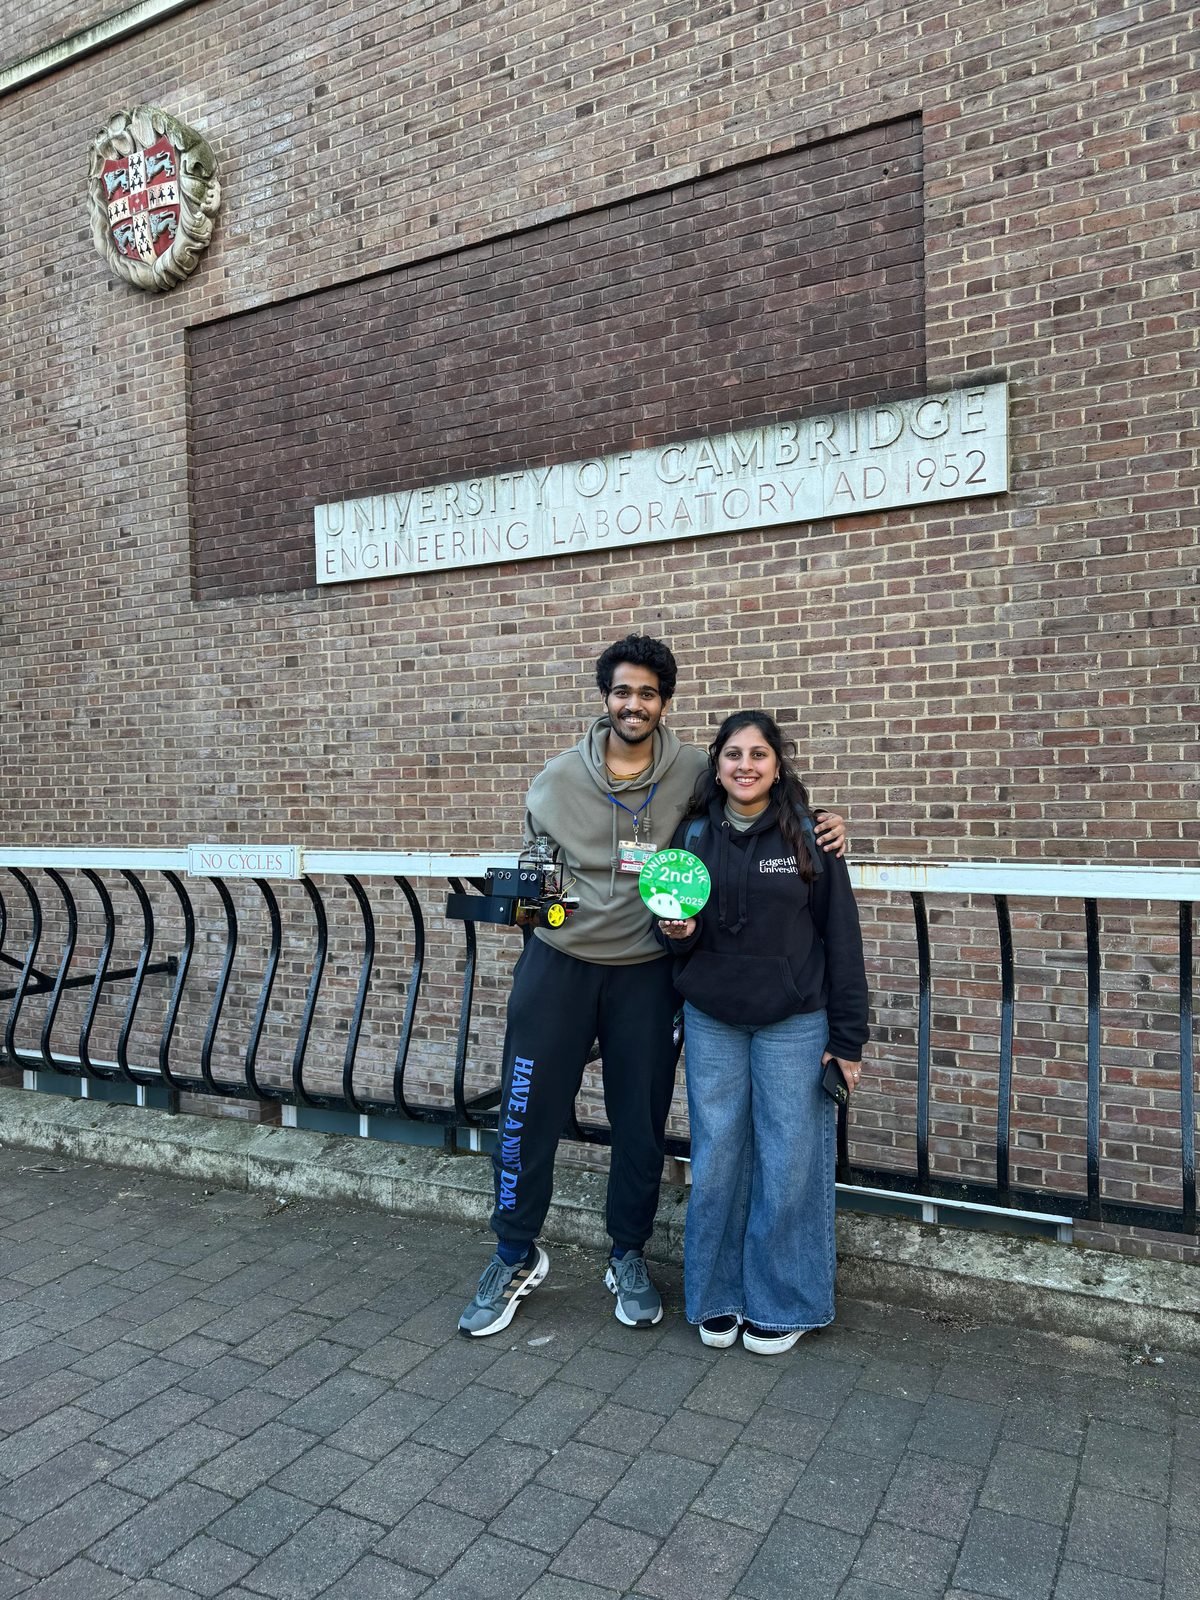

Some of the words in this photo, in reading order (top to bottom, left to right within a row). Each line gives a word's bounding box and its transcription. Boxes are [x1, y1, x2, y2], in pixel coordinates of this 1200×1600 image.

[323, 466, 553, 537] UNIVERSITY
[574, 453, 633, 498] OF
[655, 386, 988, 485] CAMBRIDGE
[325, 521, 530, 575] ENGINEERING
[551, 477, 806, 546] LABORATORY
[829, 465, 887, 506] AD
[905, 449, 988, 495] 1952
[201, 853, 223, 869] NO
[228, 854, 283, 871] CYCLES
[642, 851, 696, 880] UNIBOTS
[693, 865, 709, 884] UK
[659, 866, 693, 884] 2nd
[679, 896, 704, 906] 2025
[507, 1056, 534, 1113] HAVE
[505, 1113, 524, 1131] A
